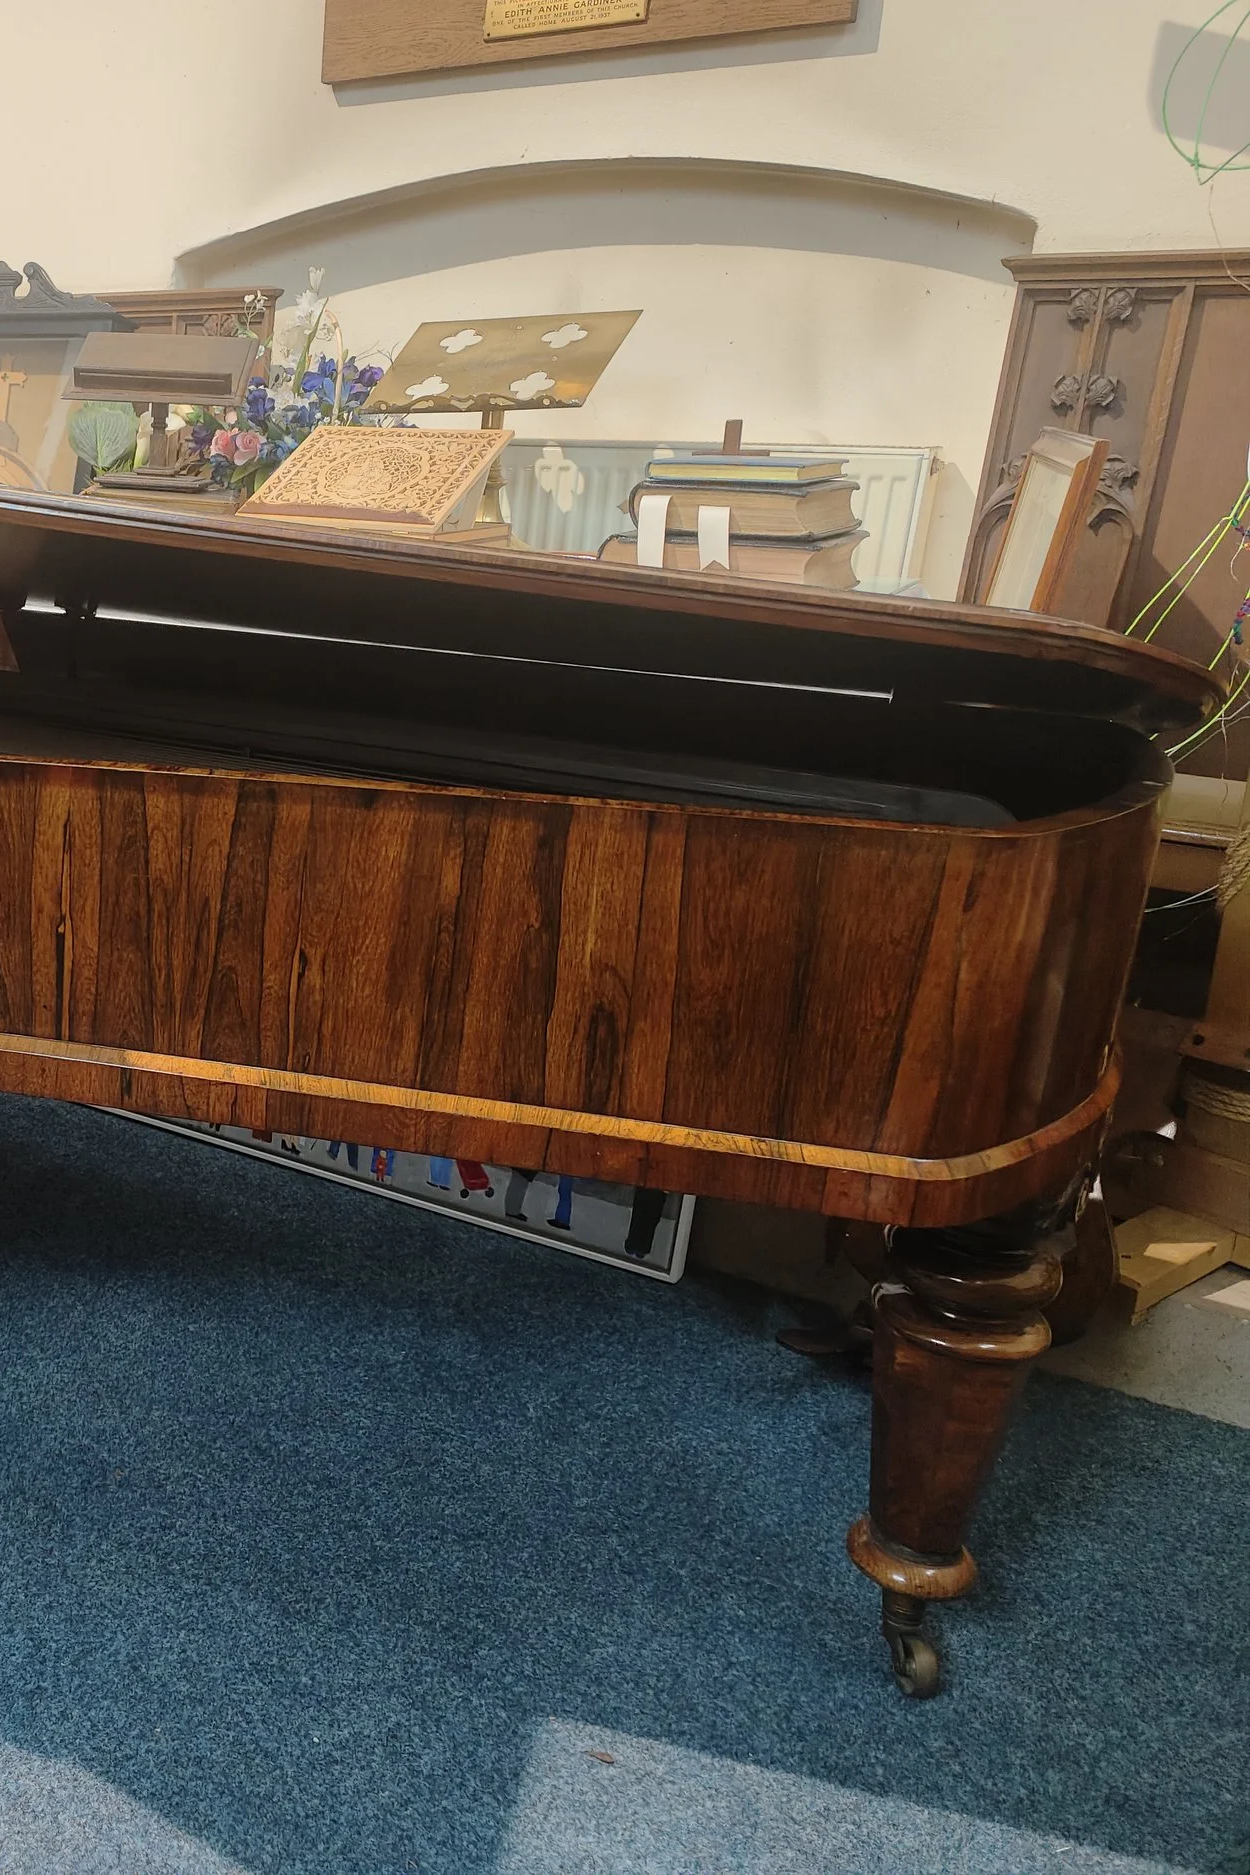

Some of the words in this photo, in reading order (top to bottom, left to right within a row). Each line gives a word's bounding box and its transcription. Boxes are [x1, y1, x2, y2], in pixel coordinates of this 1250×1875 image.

[505, 8, 532, 18] EDITH
[538, 3, 569, 14] ANNIE
[554, 9, 583, 18] MEMBERS
[613, 2, 638, 10] CHURCH
[513, 22, 536, 30] CALLED
[561, 15, 587, 23] AUGUST
